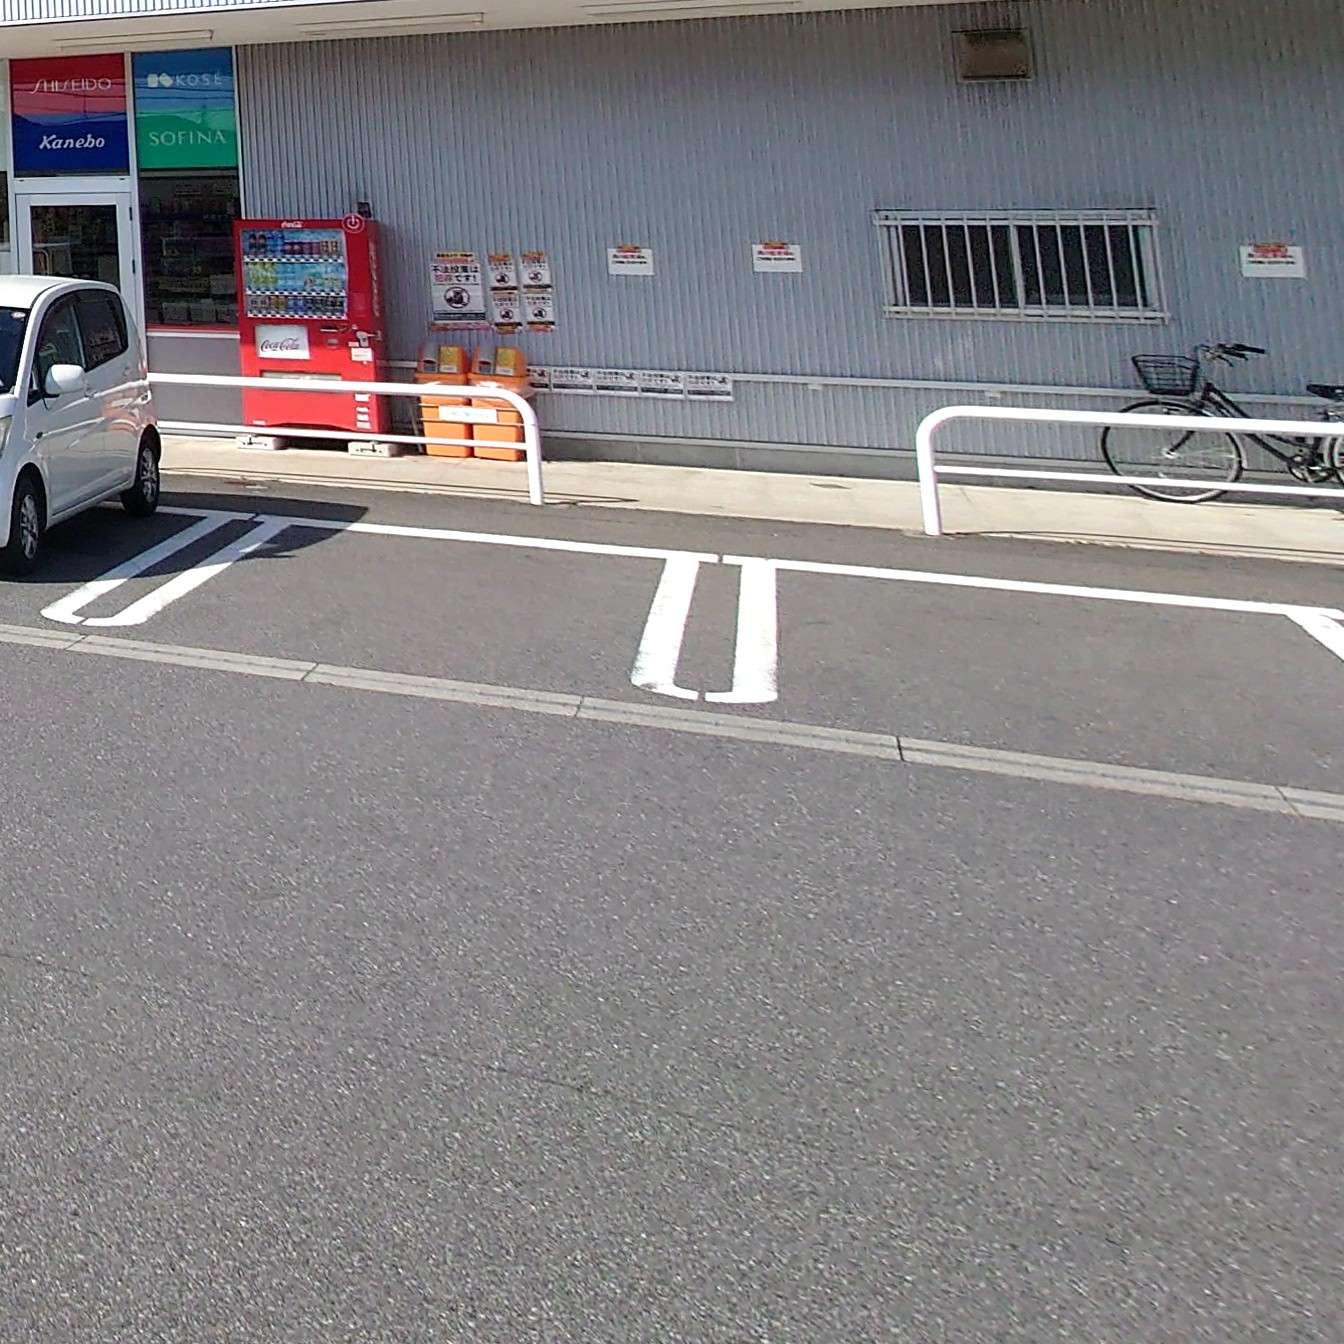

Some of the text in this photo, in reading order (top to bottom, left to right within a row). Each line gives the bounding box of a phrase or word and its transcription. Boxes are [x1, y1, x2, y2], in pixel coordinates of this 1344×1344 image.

[29, 77, 112, 94] SHISEIDO
[39, 133, 105, 149] Kanebo
[149, 130, 227, 146] SOFINA
[260, 337, 301, 352] Coca-Cola
